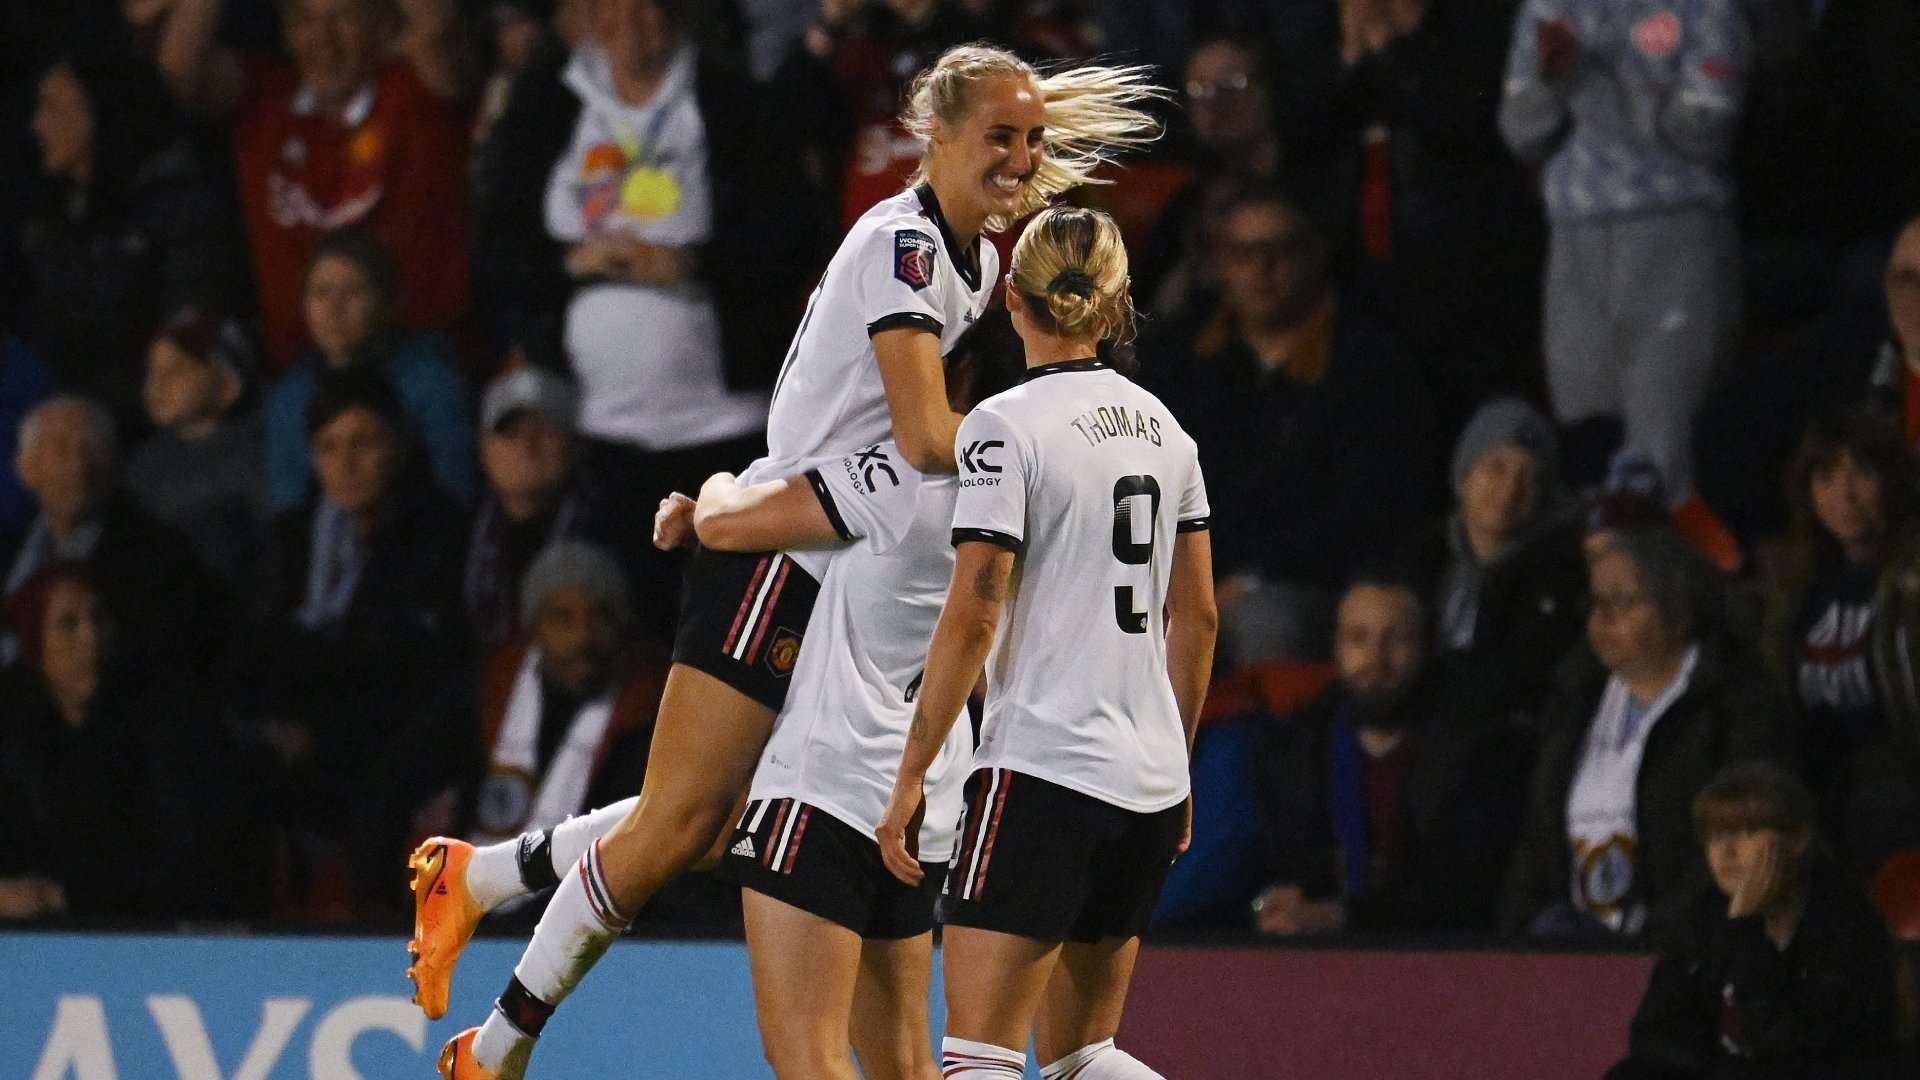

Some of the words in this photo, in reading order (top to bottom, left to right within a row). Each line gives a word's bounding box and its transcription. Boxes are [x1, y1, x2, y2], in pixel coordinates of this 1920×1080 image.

[1071, 406, 1161, 447] THOMAS
[853, 444, 900, 493] XC
[960, 440, 1004, 473] XC
[843, 458, 865, 495] OLOGY
[1112, 475, 1161, 634] 9
[731, 847, 756, 859] adidas
